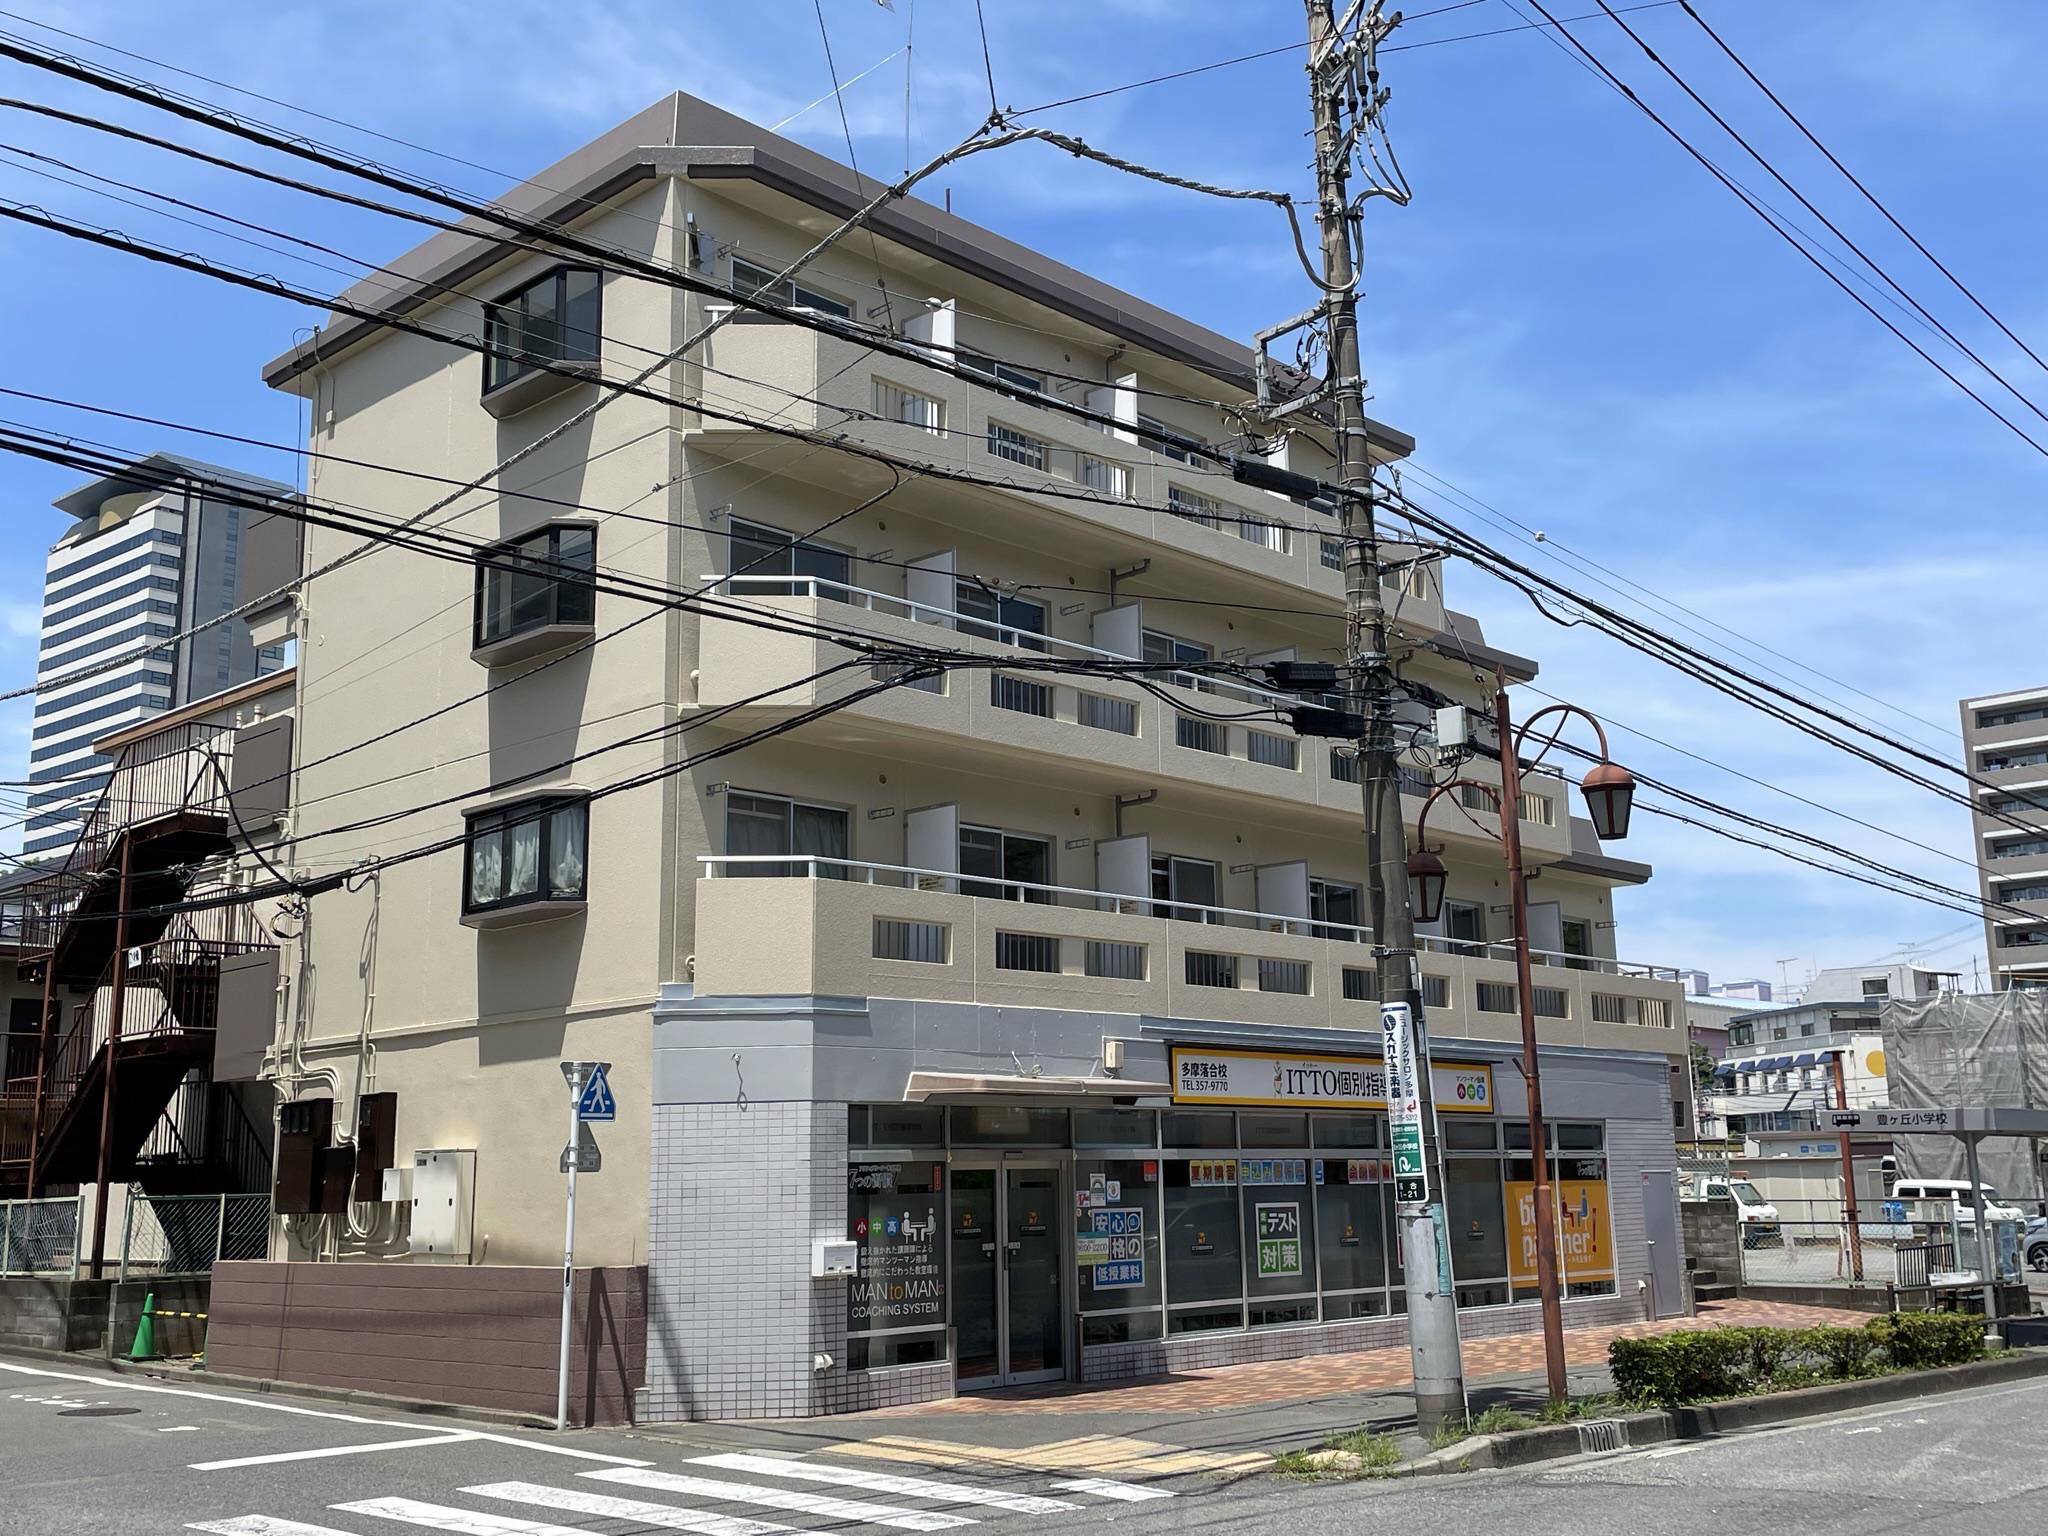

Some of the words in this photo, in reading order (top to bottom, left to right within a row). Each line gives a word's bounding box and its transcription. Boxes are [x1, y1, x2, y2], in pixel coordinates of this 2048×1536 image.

[1182, 1062, 1228, 1078] 多摩落合校
[1876, 1112, 1949, 1126] 豊ヶ丘小学校
[1267, 1211, 1297, 1233] テスト
[1262, 1244, 1298, 1270] 対策
[1096, 1264, 1141, 1282] 低授業料
[852, 1282, 888, 1302] MAN
[890, 1283, 903, 1301] to
[905, 1279, 939, 1299] MAN
[852, 1304, 901, 1318] COACHING
[902, 1302, 939, 1315] SYSTEM
